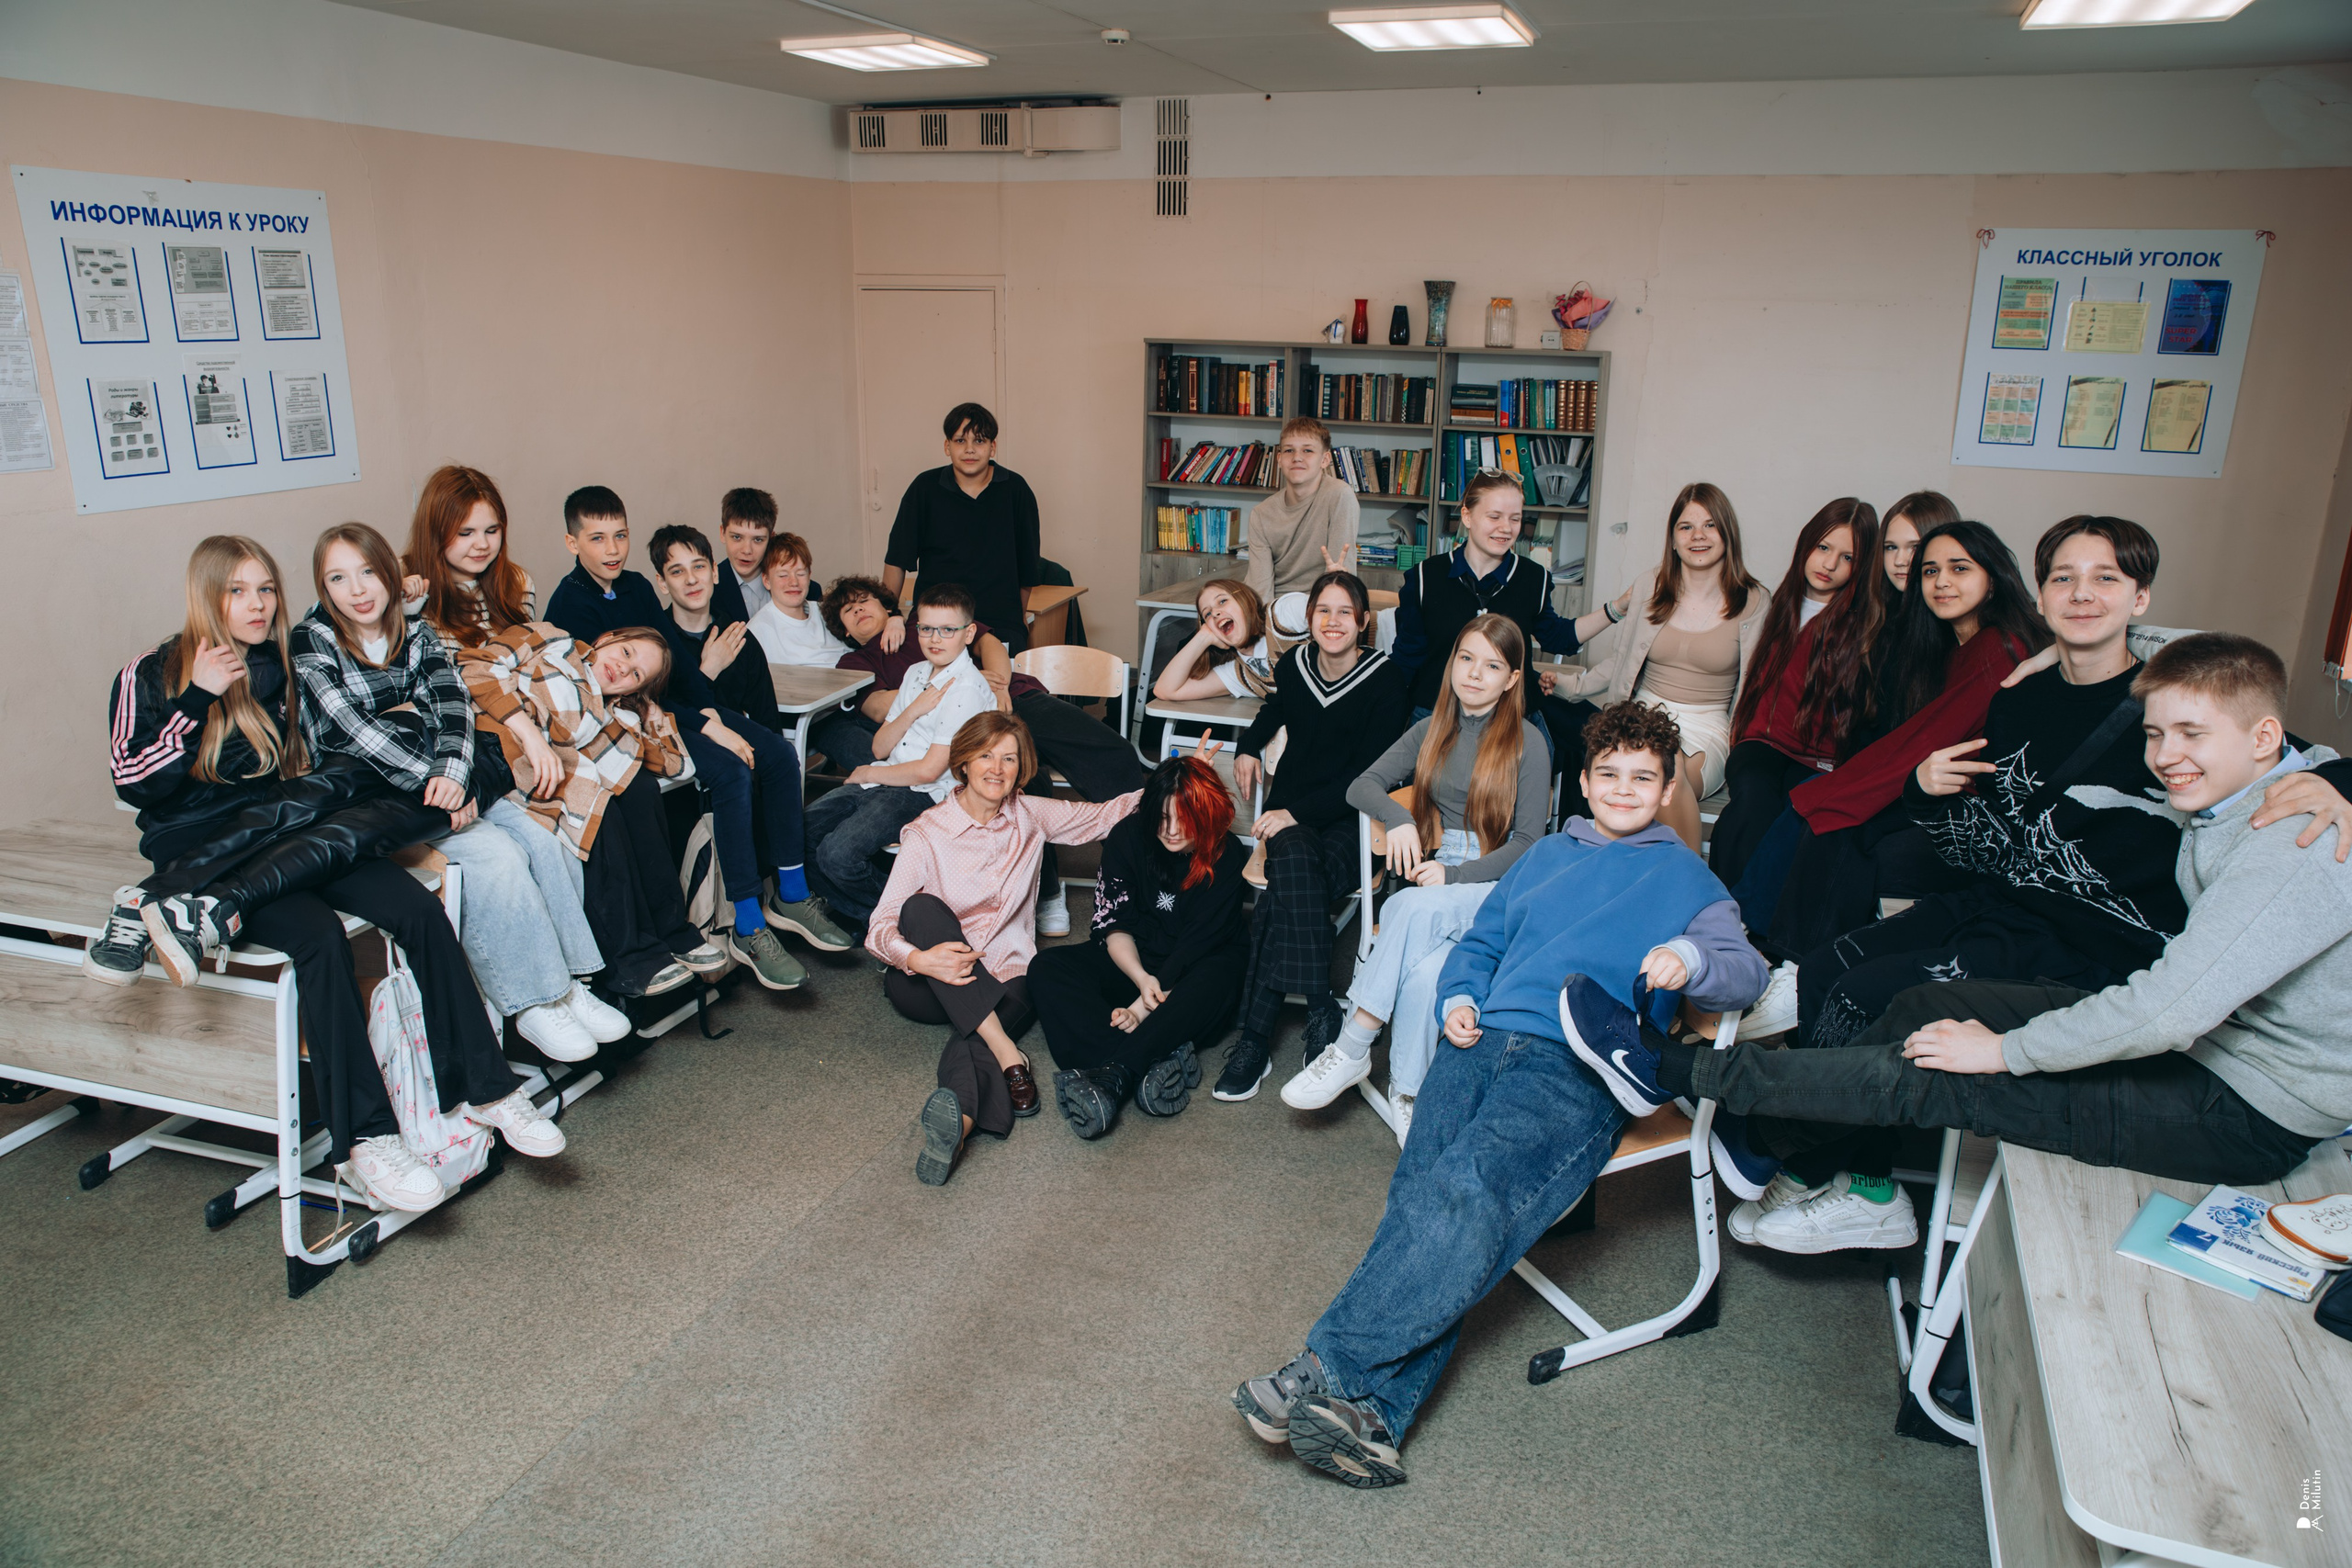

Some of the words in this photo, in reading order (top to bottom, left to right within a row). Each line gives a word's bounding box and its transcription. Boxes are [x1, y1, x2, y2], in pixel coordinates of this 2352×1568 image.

[51, 200, 223, 231] ИНФОРМАЦИЯ
[229, 212, 242, 231] К
[245, 213, 309, 233] УРОКУ
[2017, 248, 2133, 266] КЛАССНЫЙ
[2139, 252, 2222, 267] УГОЛОК
[2196, 1233, 2213, 1243] 7
[2222, 1238, 2256, 1256] язык
[2256, 1253, 2311, 1279] Русский
